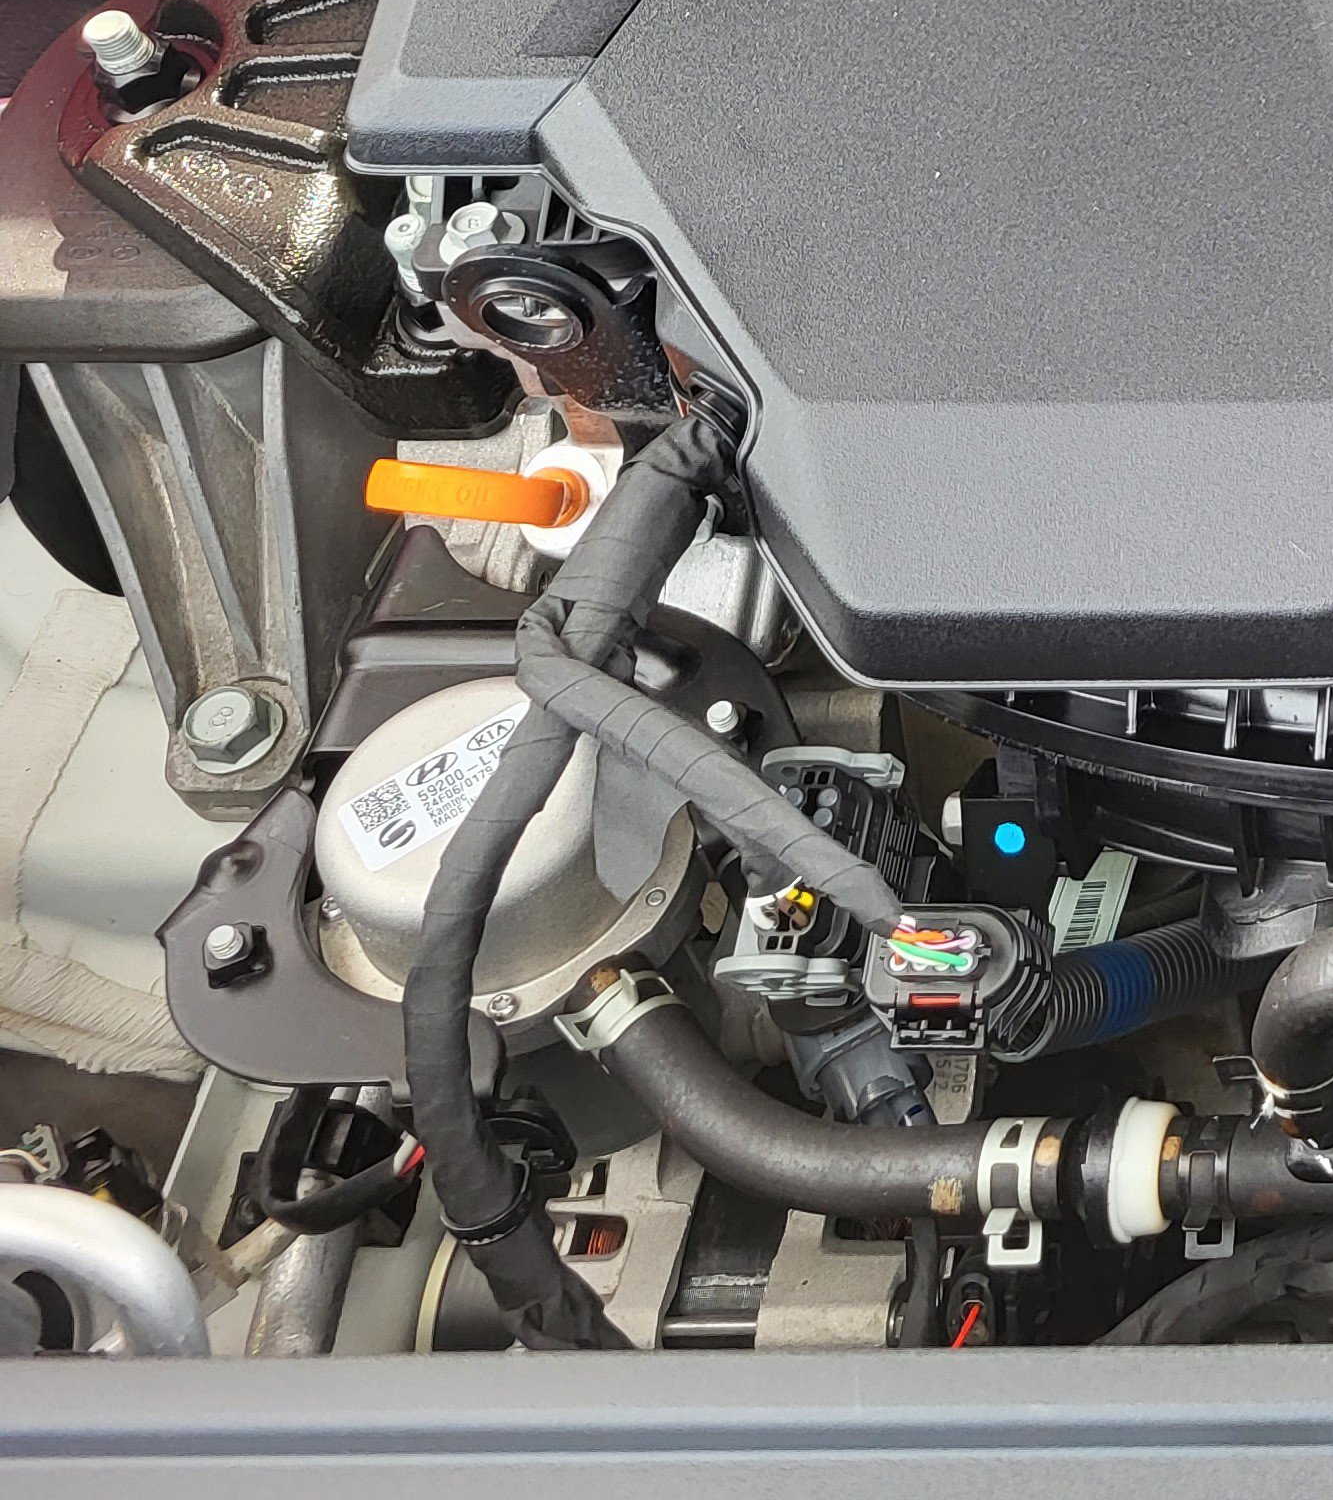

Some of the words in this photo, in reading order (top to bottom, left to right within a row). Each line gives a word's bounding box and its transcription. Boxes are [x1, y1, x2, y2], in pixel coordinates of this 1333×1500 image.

[473, 723, 509, 748] KIA
[428, 792, 468, 819] Kamtec
[433, 806, 466, 828] MADE
